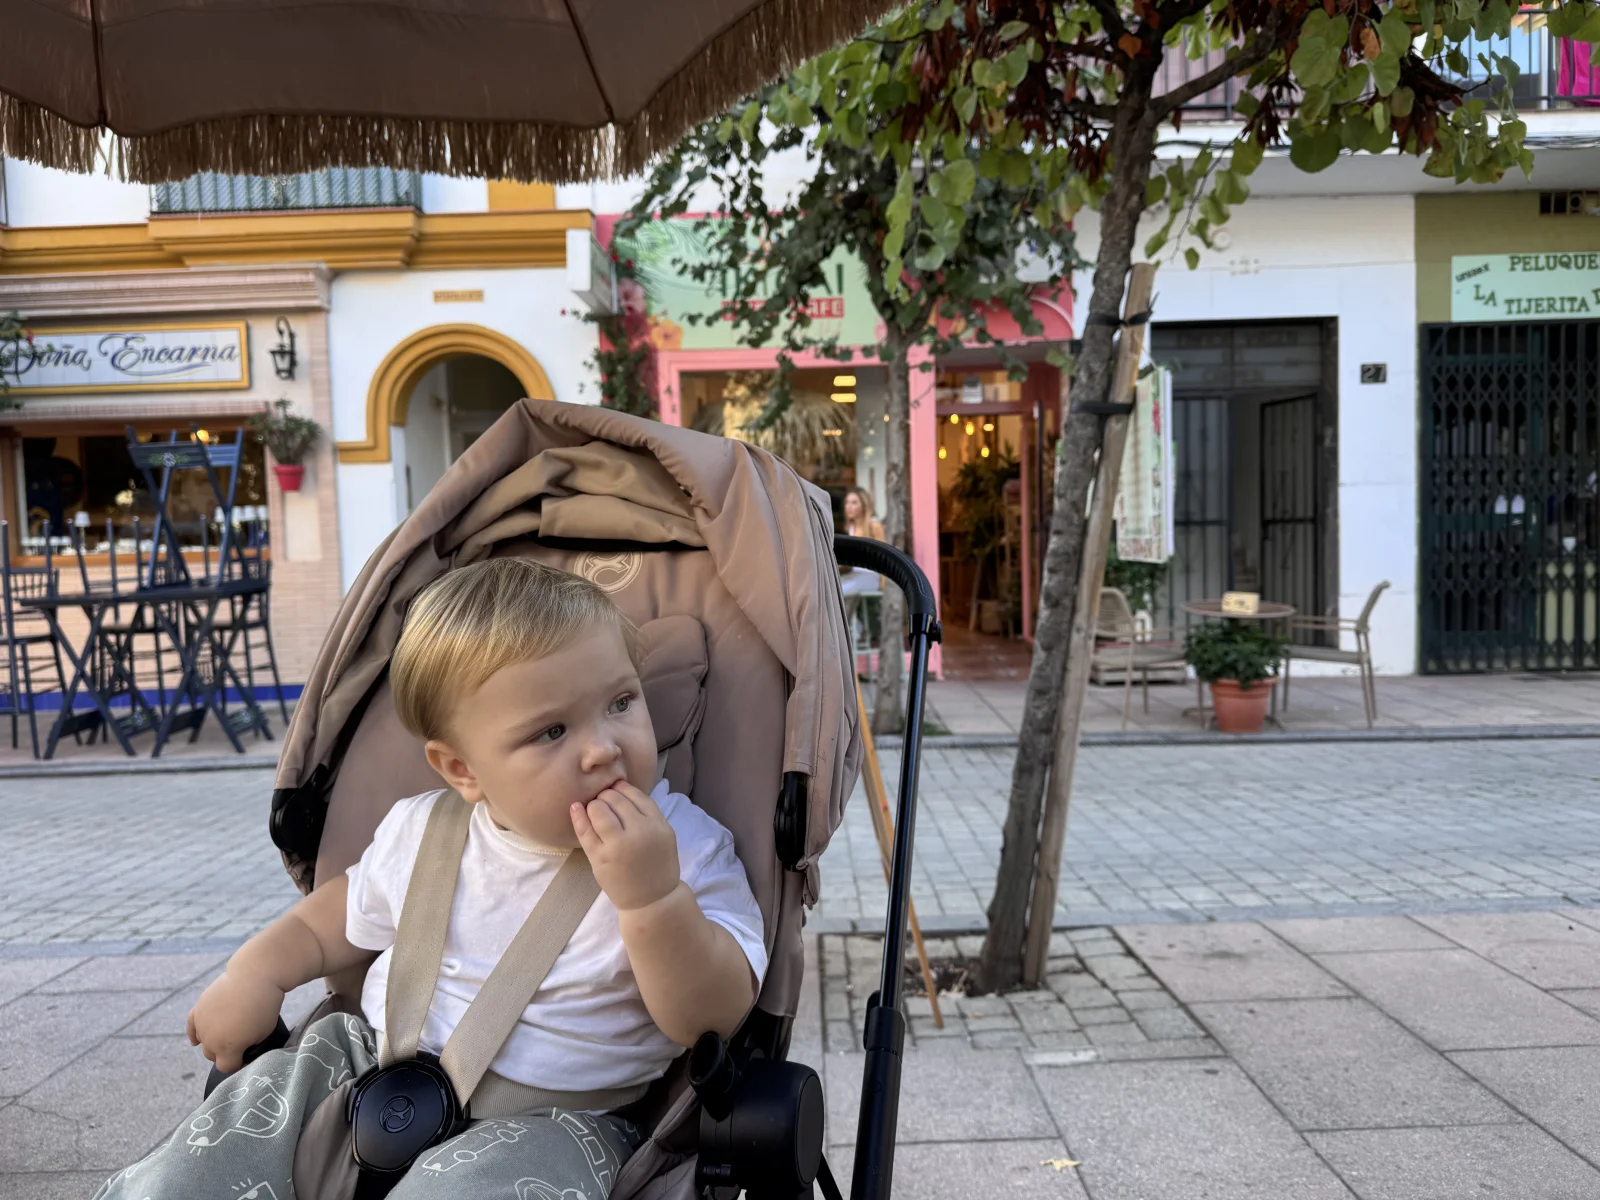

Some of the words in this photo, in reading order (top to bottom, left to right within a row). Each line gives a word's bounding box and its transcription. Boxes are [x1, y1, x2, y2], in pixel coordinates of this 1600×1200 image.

[1474, 284, 1497, 307] LA
[1504, 297, 1590, 315] TIJERITA
[98, 333, 237, 375] Encarna
